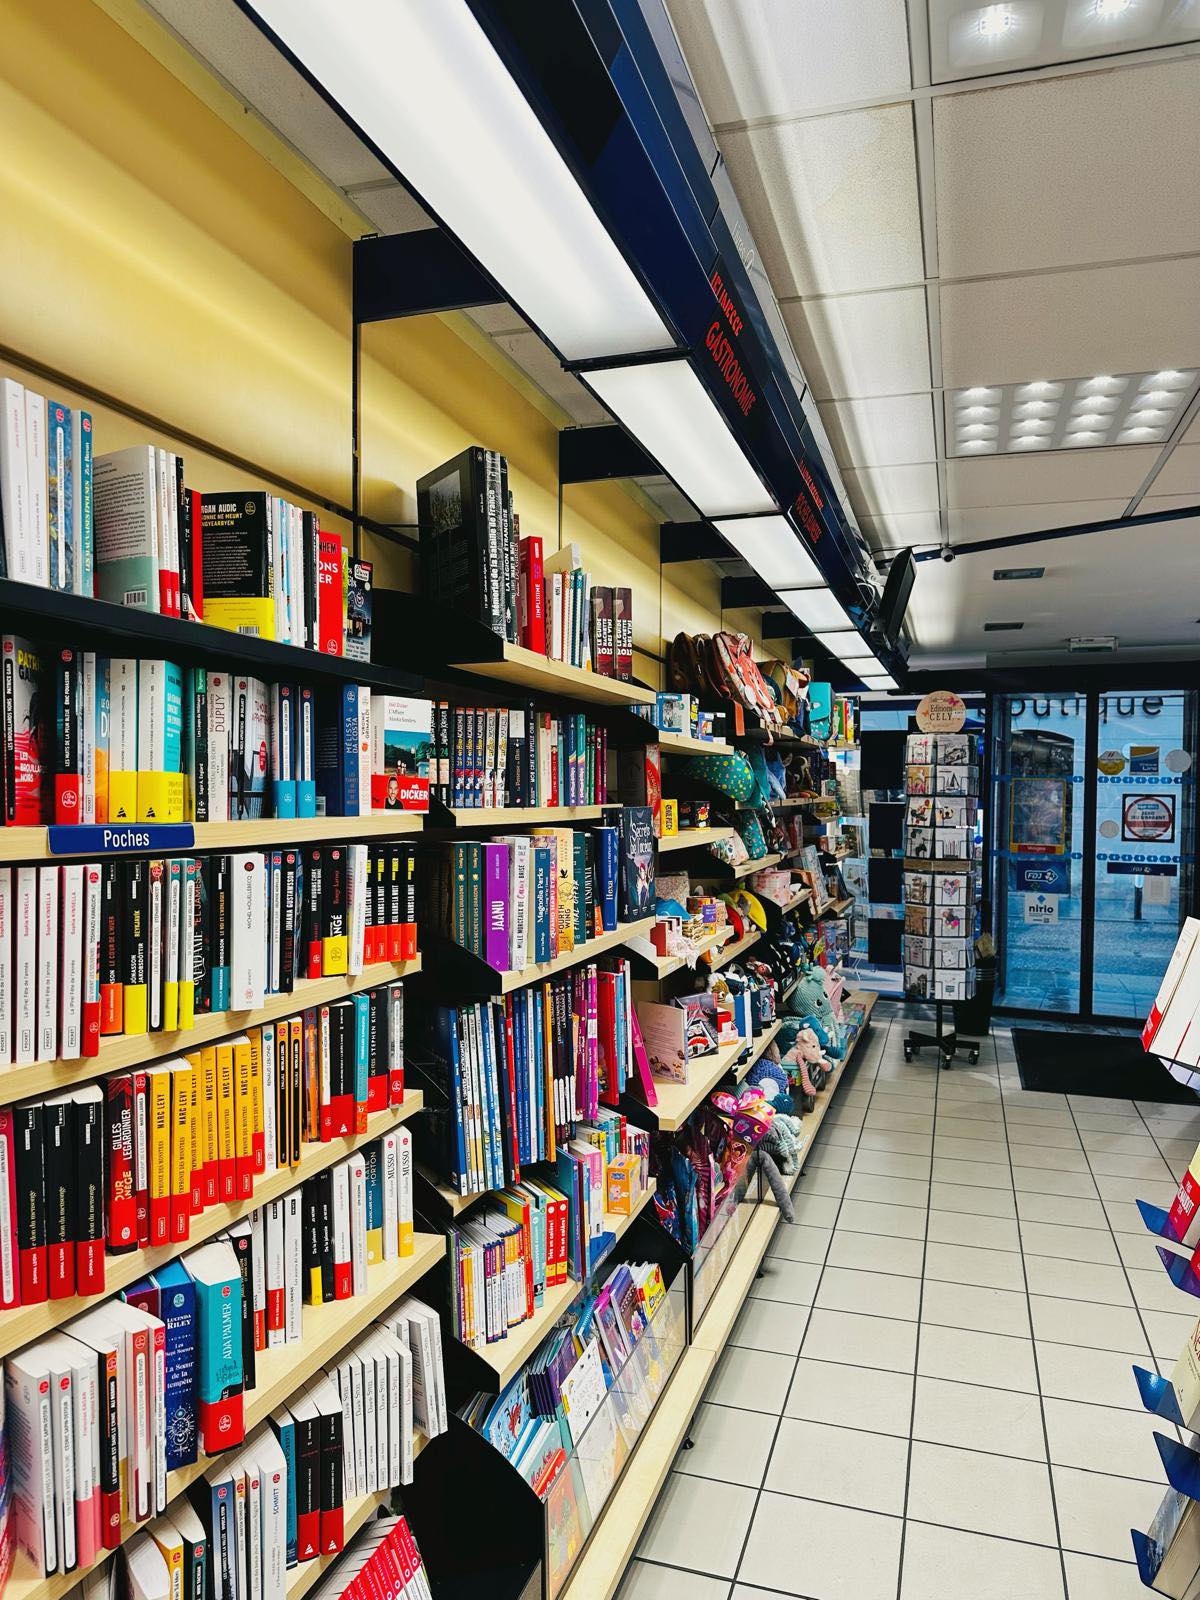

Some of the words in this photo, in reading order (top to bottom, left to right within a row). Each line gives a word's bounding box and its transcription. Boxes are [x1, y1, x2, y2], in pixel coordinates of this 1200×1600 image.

[705, 321, 756, 417] GASTRONOMIE
[218, 503, 237, 513] AUDIC
[487, 490, 496, 516] France
[488, 517, 497, 526] de
[488, 528, 498, 558] Bataille
[490, 560, 498, 568] la
[490, 569, 499, 580] de
[505, 582, 510, 592] LA
[491, 581, 500, 615] Mémorial
[214, 694, 225, 732] DUPUY
[930, 712, 952, 720] CELY
[352, 744, 358, 754] DA
[400, 789, 429, 801] DICKER
[103, 828, 150, 849] Poches
[1028, 872, 1043, 880] FDJ
[286, 871, 294, 908] GUSTAWSSON
[584, 867, 592, 904] INSOMNIA
[491, 900, 504, 931] JAANU
[1029, 905, 1054, 914] nirio
[156, 1094, 165, 1109] LEVY
[178, 1091, 186, 1106] LEVY
[156, 1111, 165, 1129] MARC
[178, 1107, 186, 1126] MARC
[112, 1123, 122, 1150] GILLES
[120, 1108, 132, 1160] LEGARDINIER
[387, 1154, 395, 1179] MUSSO
[29, 1190, 37, 1220] mensonge
[58, 1186, 66, 1216] mensonge
[29, 1230, 37, 1242] don
[57, 1225, 66, 1237] don
[167, 1314, 191, 1322] LUCINDA
[167, 1320, 191, 1330] RILEY
[222, 1303, 232, 1340] PALMER
[222, 1341, 232, 1359] ADA
